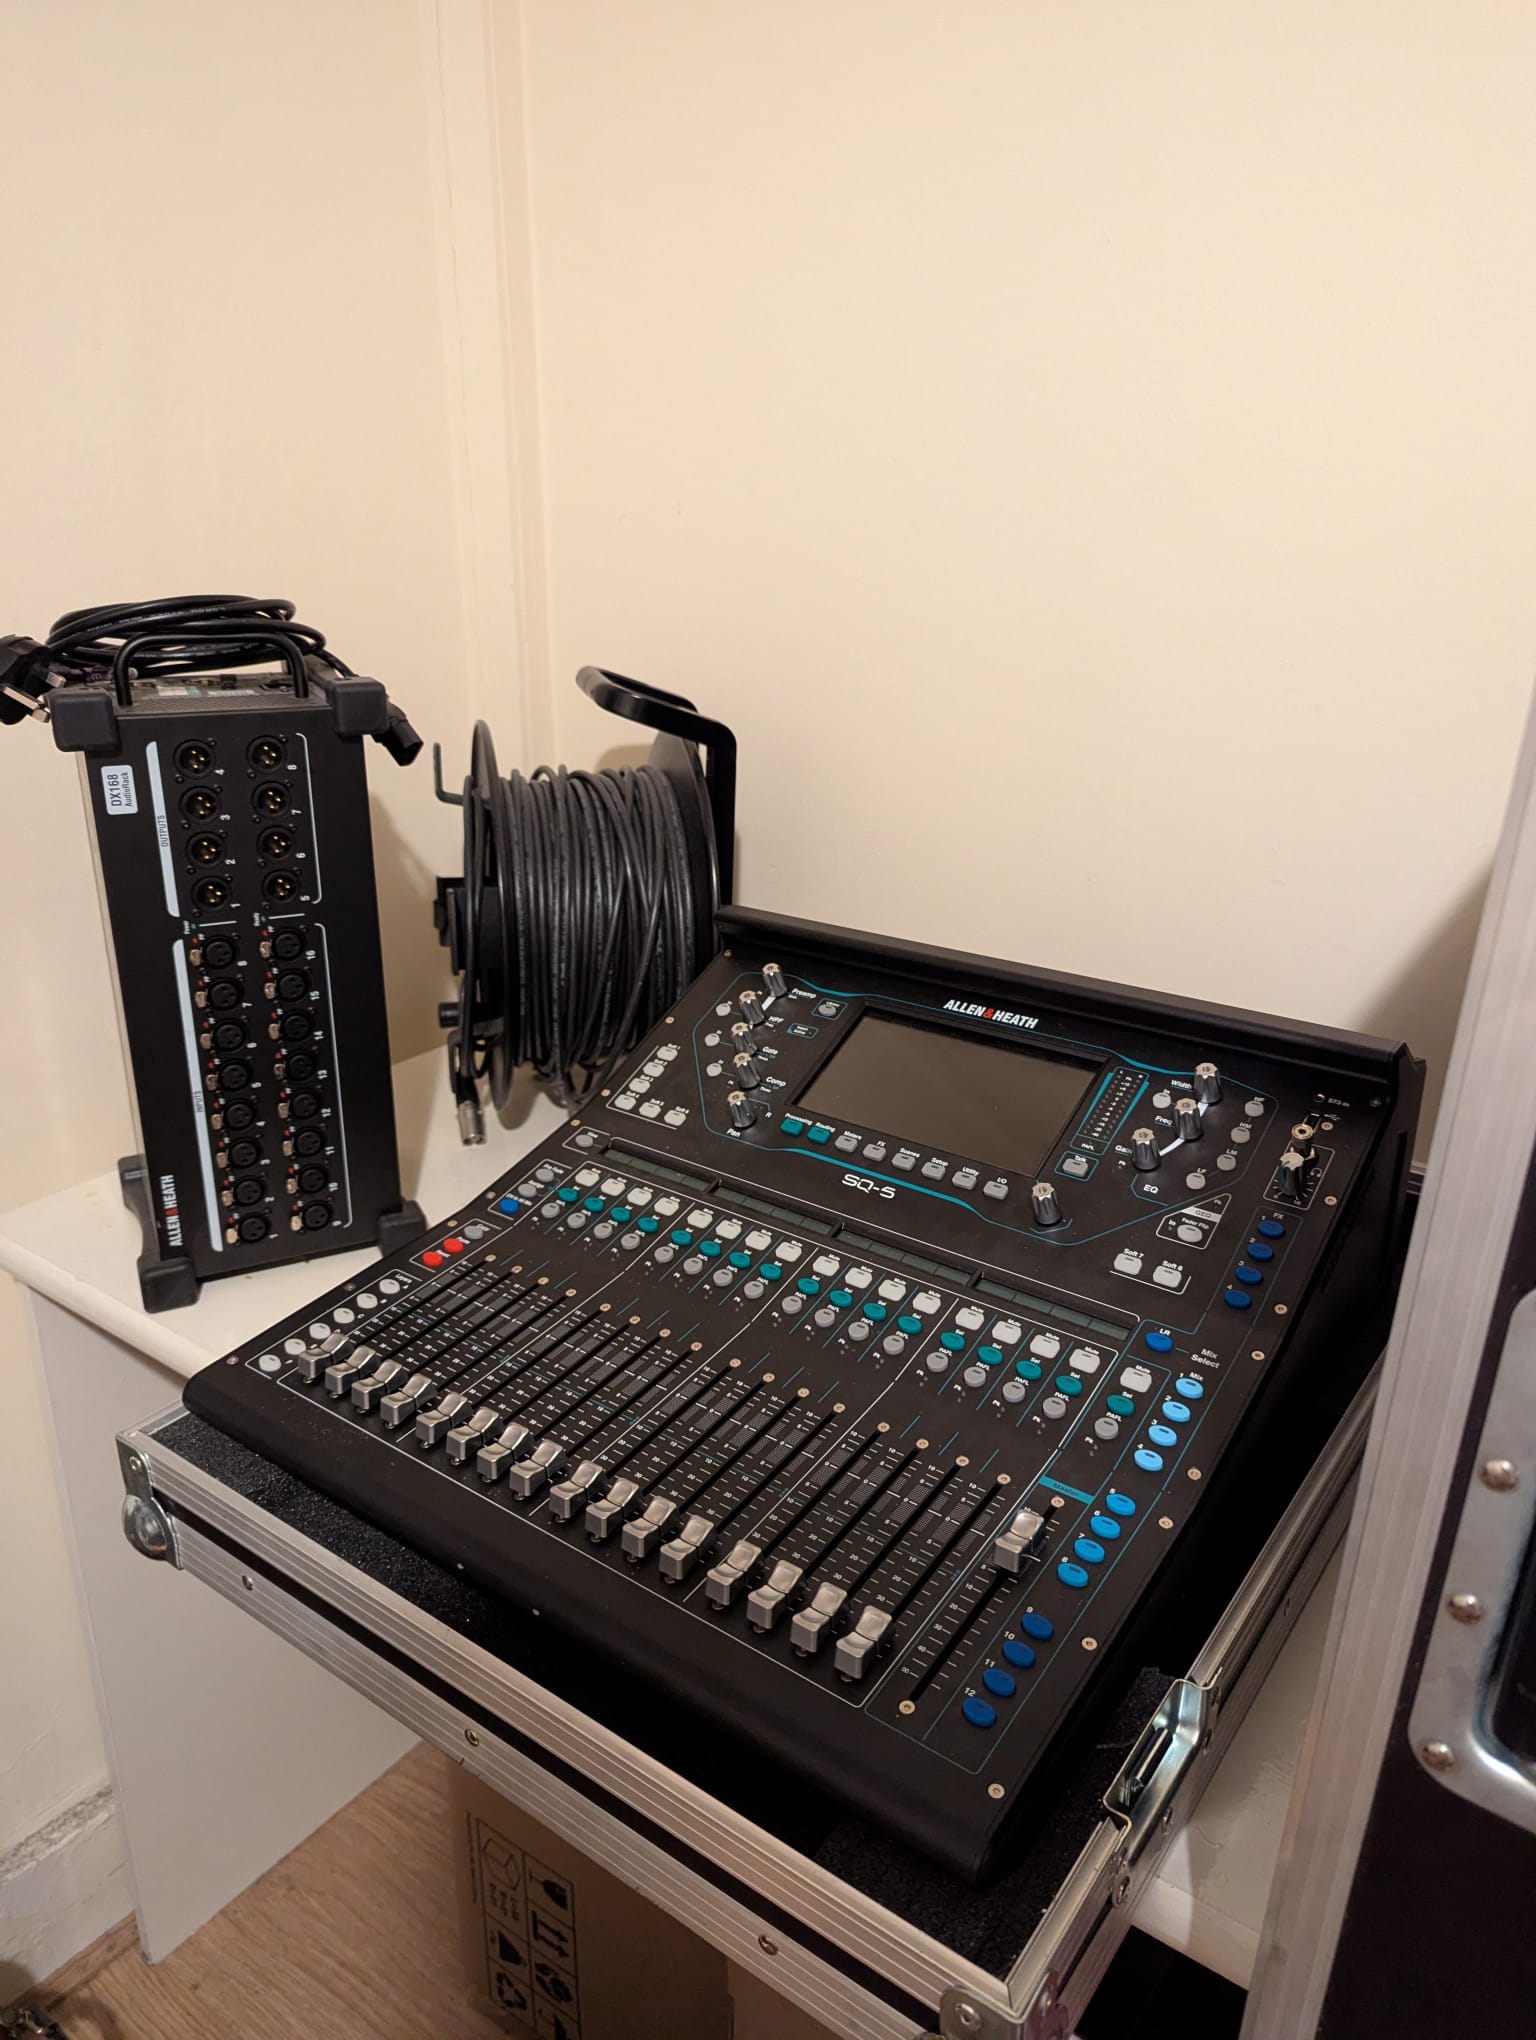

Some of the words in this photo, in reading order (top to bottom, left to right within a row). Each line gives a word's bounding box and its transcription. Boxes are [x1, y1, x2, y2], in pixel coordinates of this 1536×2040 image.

[107, 774, 122, 806] DX168
[121, 772, 133, 807] AudioRack
[158, 815, 168, 848] OUTPUTS
[792, 988, 816, 998] Preamp
[943, 1000, 1039, 1028] ALLEN&HEATH
[314, 1030, 324, 1040] 14
[762, 1046, 778, 1055] Gate
[766, 1076, 786, 1086] Comp
[1171, 1080, 1192, 1088] Width
[1155, 1116, 1173, 1126] Freq
[726, 1128, 740, 1137] Pan
[900, 1148, 920, 1158] Scenes
[1115, 1144, 1132, 1154] Gain
[932, 1157, 948, 1167] Setup
[962, 1166, 980, 1176] Utility
[842, 1174, 896, 1199] SQ-5
[1144, 1184, 1159, 1194] EQ
[160, 1174, 184, 1246] ALLEN&HEATH
[1273, 1212, 1284, 1220] FX
[1182, 1217, 1198, 1226] Fader
[1124, 1248, 1138, 1256] Soft
[1162, 1260, 1176, 1269] Soft
[1160, 1328, 1170, 1336] LR
[1201, 1348, 1218, 1359] Mix
[1190, 1354, 1220, 1368] Select
[1135, 1365, 1151, 1374] Mute
[1190, 1372, 1204, 1380] Mix
[876, 1594, 886, 1602] 30
[948, 1602, 958, 1610] 20
[1004, 1631, 1016, 1640] 10
[984, 1658, 996, 1668] 11
[964, 1687, 976, 1697] 12
